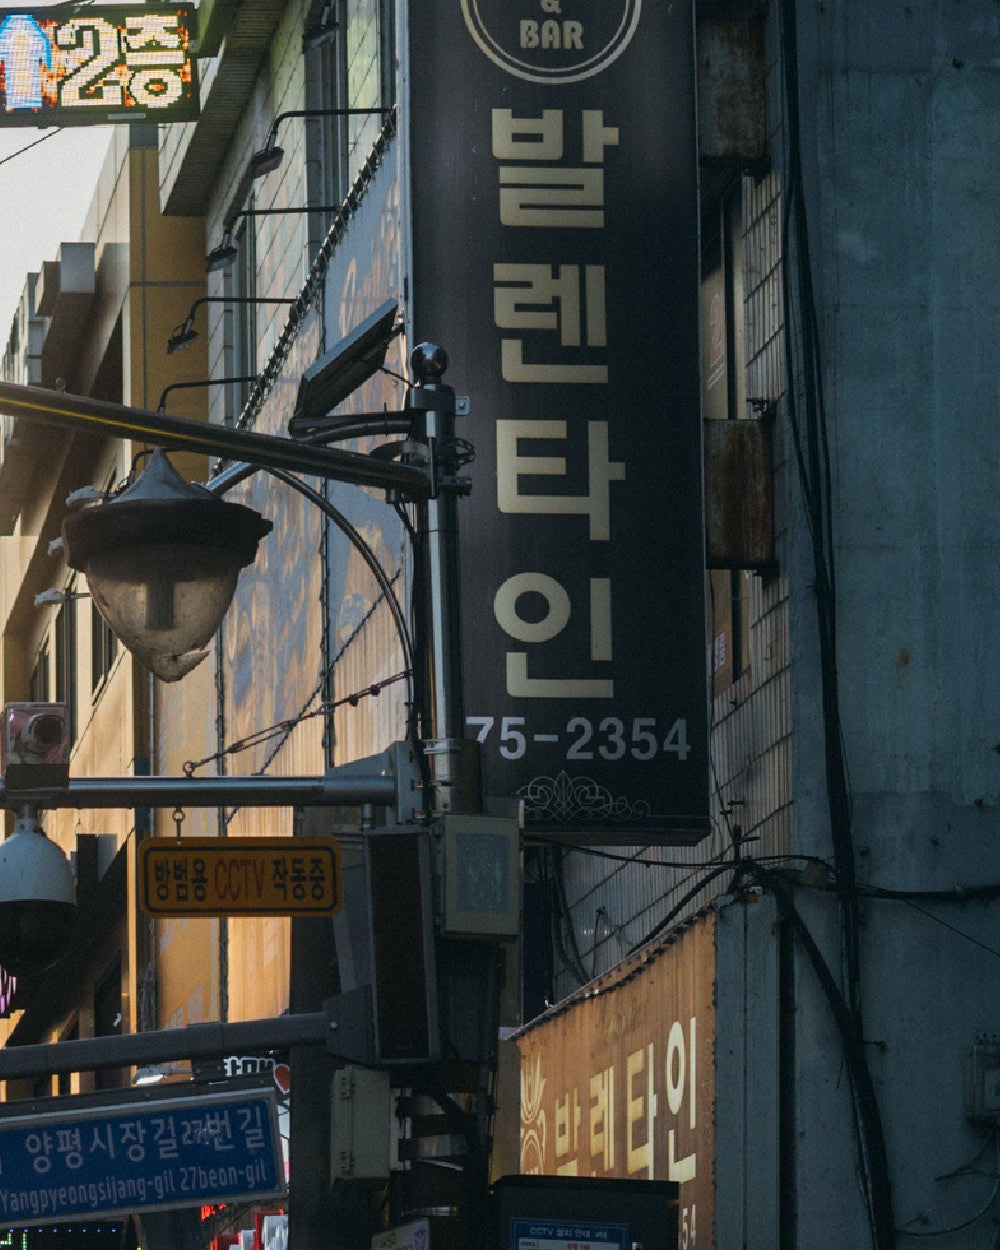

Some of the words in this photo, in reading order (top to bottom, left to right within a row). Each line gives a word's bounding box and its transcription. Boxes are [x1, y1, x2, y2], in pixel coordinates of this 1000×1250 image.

[520, 19, 585, 50] BAR
[491, 108, 627, 699] 발렌타인
[214, 857, 265, 902] CCTV
[271, 856, 326, 902] 작동중
[0, 1168, 177, 1213] Yangpyeongsijang-gil
[181, 1158, 269, 1191] 27beon-gil
